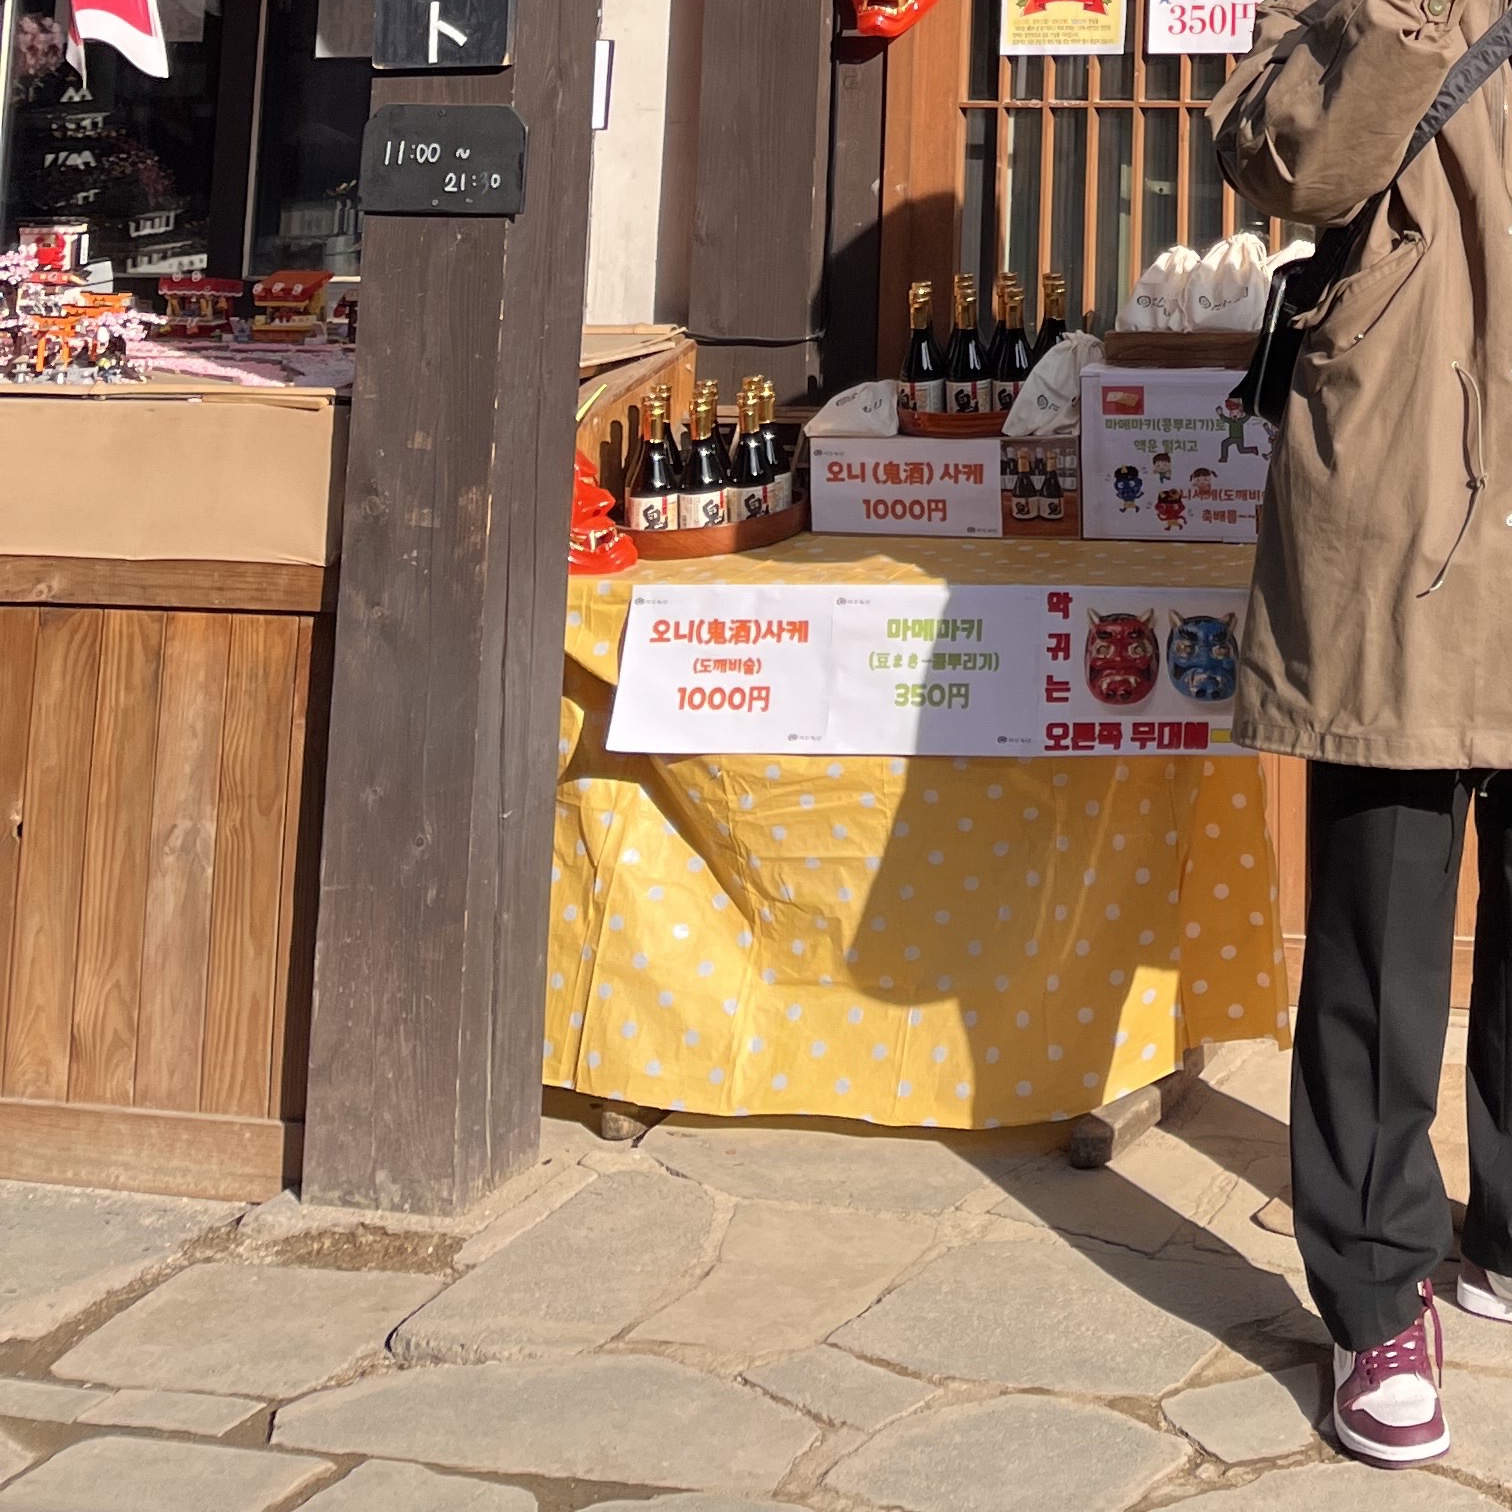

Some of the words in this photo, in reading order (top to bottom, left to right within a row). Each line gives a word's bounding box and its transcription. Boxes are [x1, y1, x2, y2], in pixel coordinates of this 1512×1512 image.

[384, 141, 441, 166] 11:00
[826, 461, 866, 483] 오니
[939, 463, 984, 485] 사케
[862, 499, 947, 523] 1000円
[649, 619, 809, 644] 오니(鬼酒)사케
[886, 619, 983, 642] 마메마키
[693, 657, 762, 675] (도깨비술)
[677, 686, 771, 712] 1000円
[894, 683, 970, 709] 350円
[1044, 722, 1122, 751] 오른쪽
